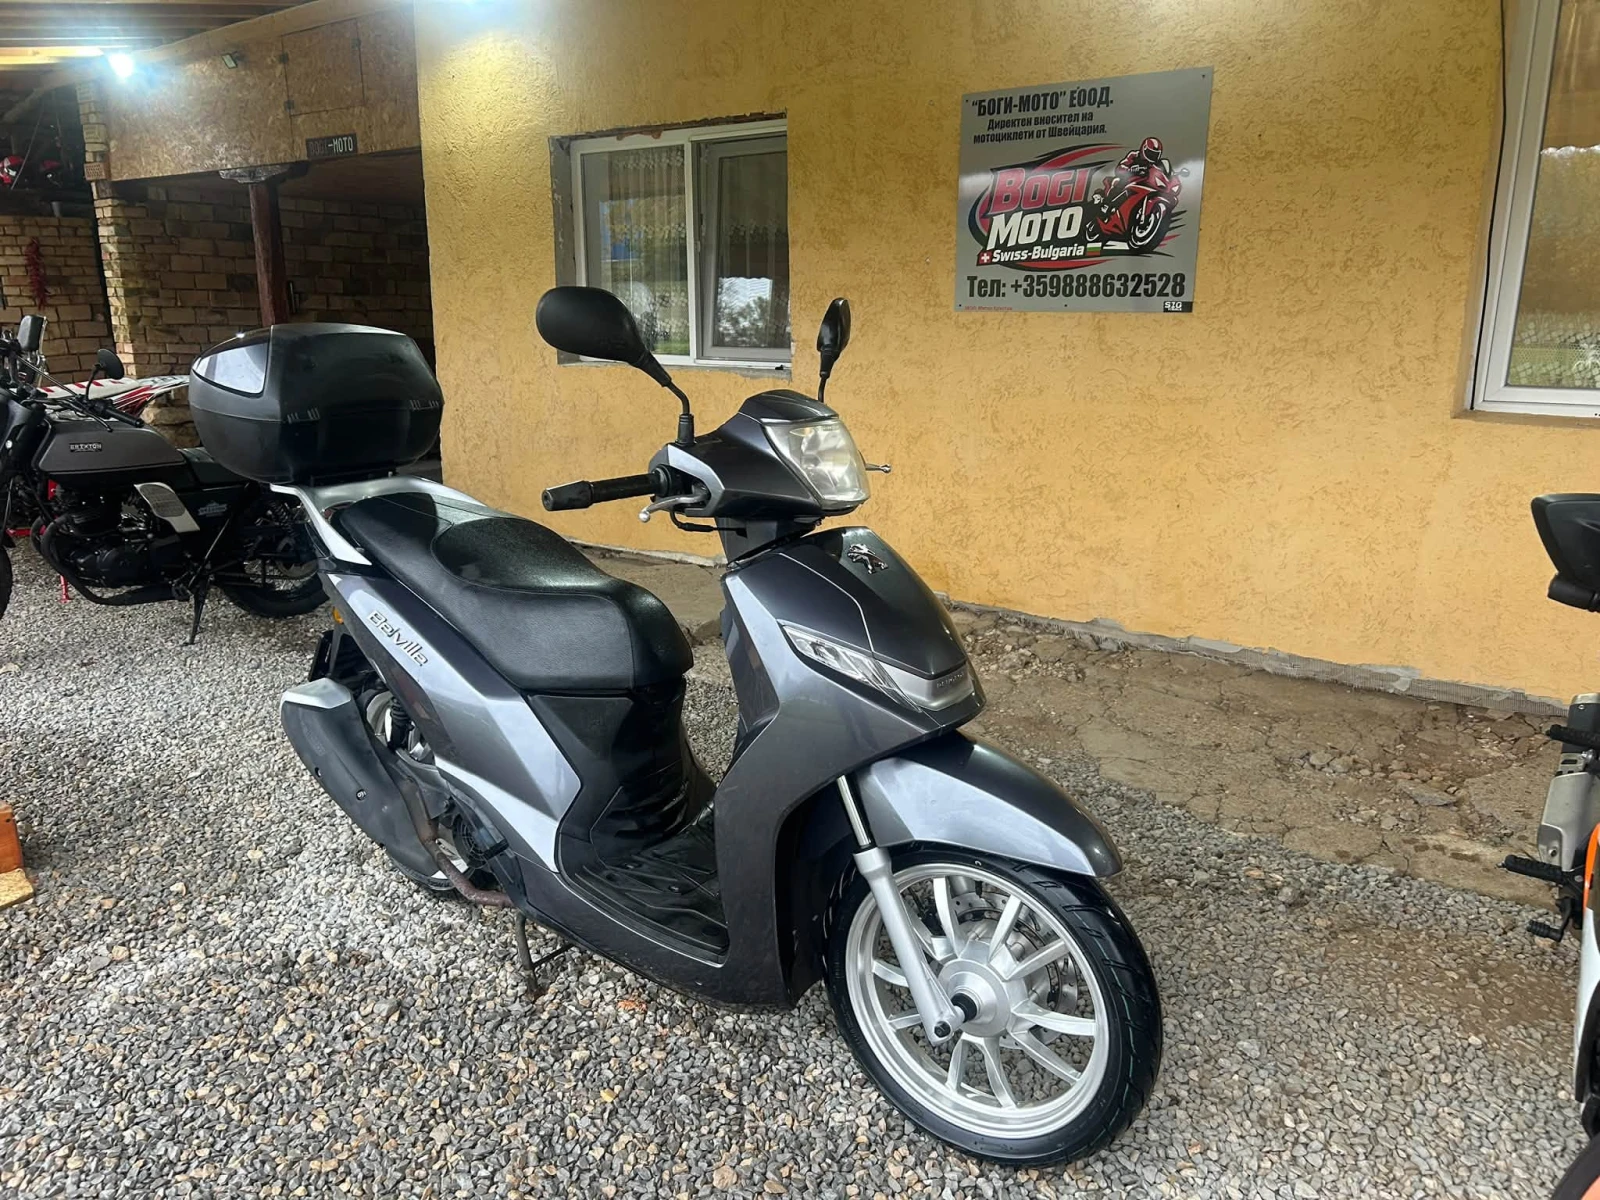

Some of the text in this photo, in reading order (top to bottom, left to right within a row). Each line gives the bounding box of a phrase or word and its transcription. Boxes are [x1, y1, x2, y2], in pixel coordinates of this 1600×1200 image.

[1069, 86, 1114, 108] ЕООД.
[973, 124, 1107, 144] мотоциклети от Швейцария.
[987, 112, 1094, 131] Директен вносител на
[990, 167, 1091, 214] BOGI
[986, 206, 1084, 250] MOTO
[967, 272, 1186, 298] Тел: +359888632528
[369, 611, 429, 667] Belville
